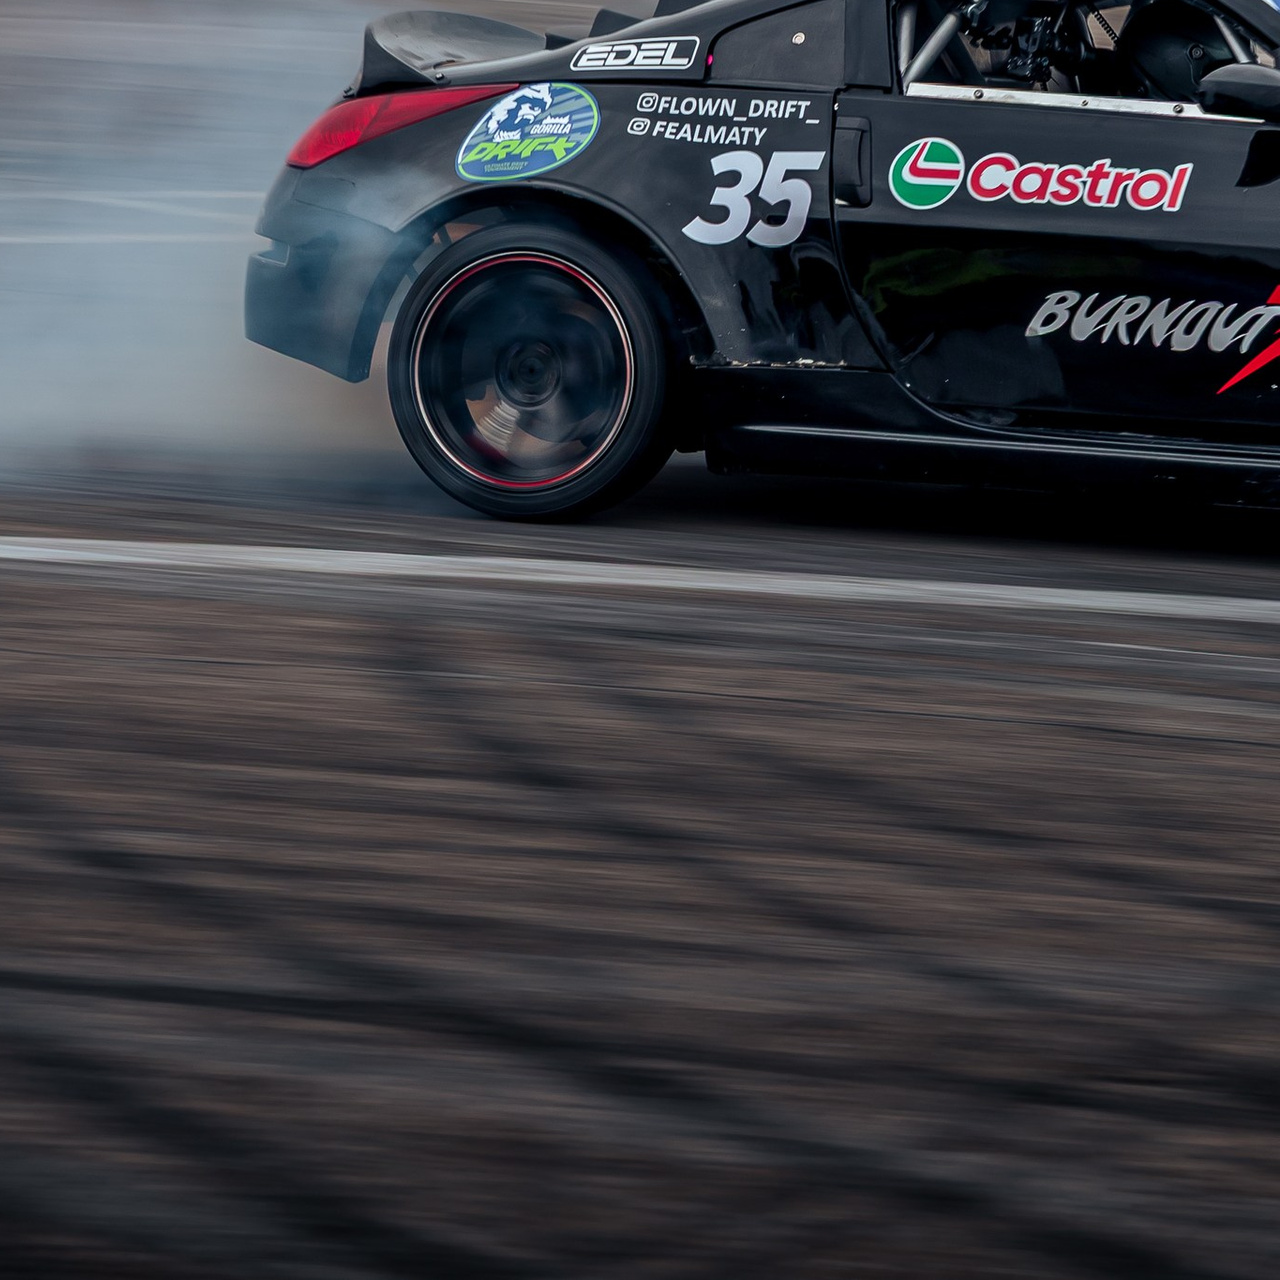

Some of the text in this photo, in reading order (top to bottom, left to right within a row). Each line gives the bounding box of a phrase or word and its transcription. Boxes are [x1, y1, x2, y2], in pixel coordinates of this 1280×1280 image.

[577, 41, 690, 67] EDEL
[657, 96, 820, 125] FLOWN_DRIFT_
[530, 123, 572, 135] GORILLA
[652, 121, 768, 147] FEALMATY
[461, 136, 577, 162] DRIFT
[967, 153, 1194, 211] Castrol
[681, 150, 826, 248] 35
